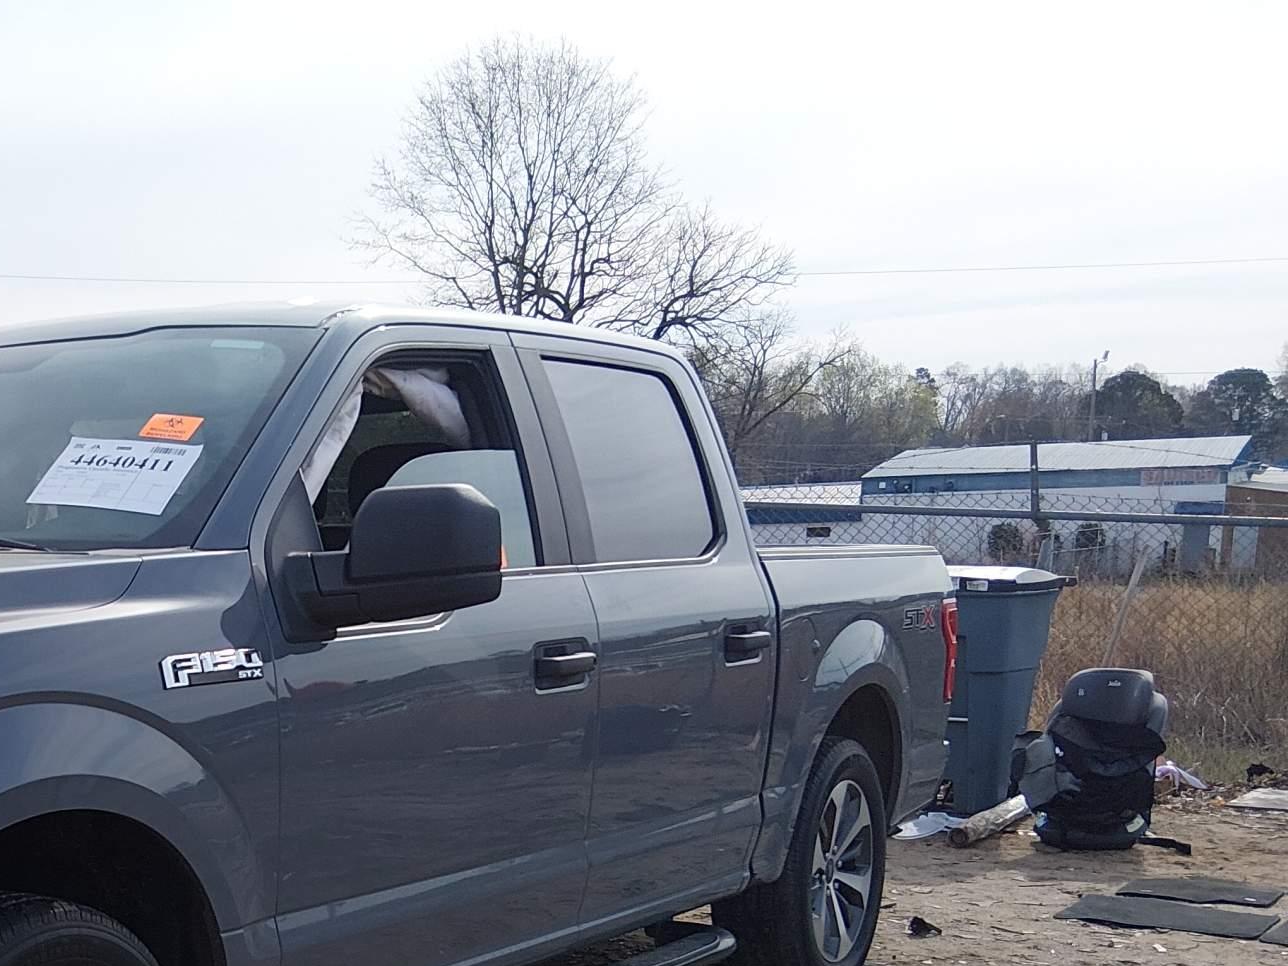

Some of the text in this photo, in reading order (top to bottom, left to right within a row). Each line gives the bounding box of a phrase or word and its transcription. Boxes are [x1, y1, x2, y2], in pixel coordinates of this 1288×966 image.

[70, 454, 174, 472] 44640411
[903, 604, 935, 629] STX
[238, 668, 263, 679] STX
